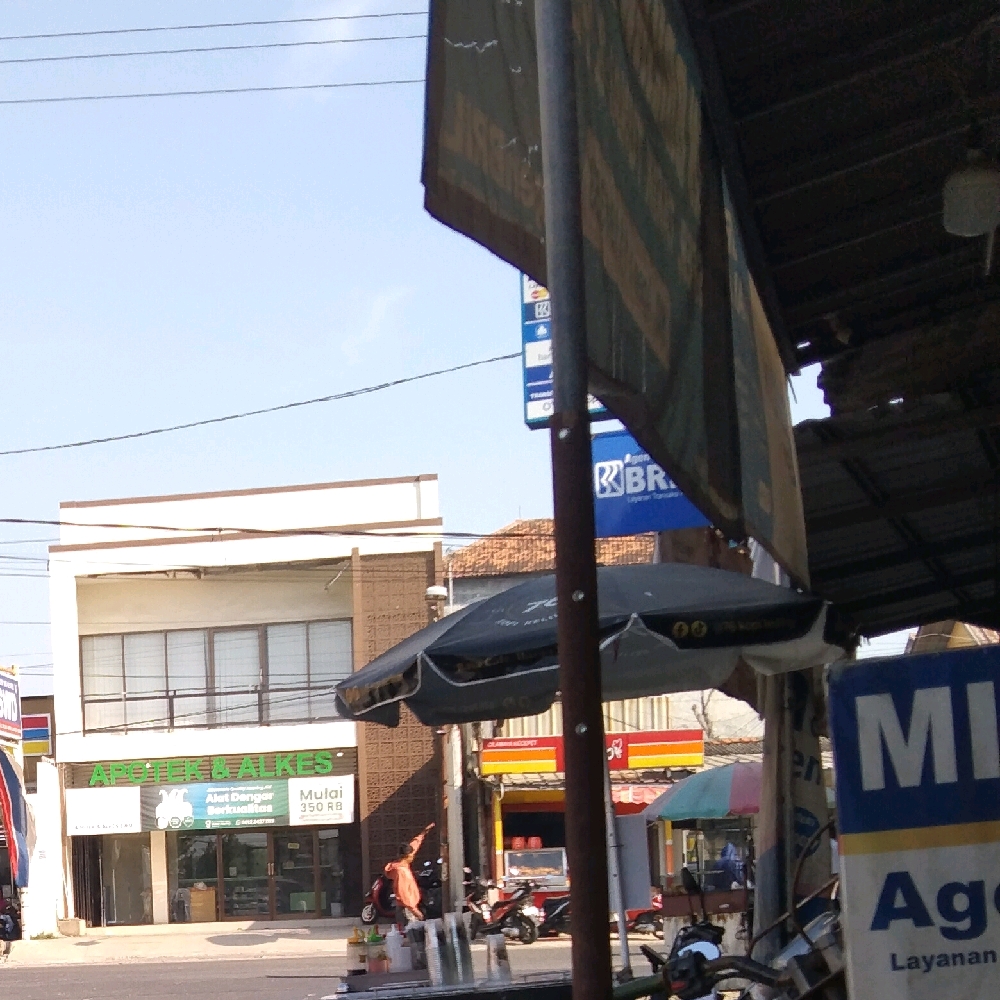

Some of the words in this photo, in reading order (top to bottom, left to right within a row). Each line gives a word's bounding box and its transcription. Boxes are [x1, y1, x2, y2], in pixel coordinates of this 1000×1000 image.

[855, 681, 999, 792] MI
[89, 759, 203, 786] APOTEK
[211, 757, 230, 779] &
[237, 750, 333, 778] ALKES
[205, 793, 229, 803] Alat
[231, 793, 274, 804] Dengar
[300, 786, 343, 801] Mulai
[207, 803, 272, 816] Berkualitas
[300, 801, 323, 813] 350
[328, 801, 343, 811] RB
[871, 871, 1000, 940] Ag
[891, 949, 997, 972] Layanan
